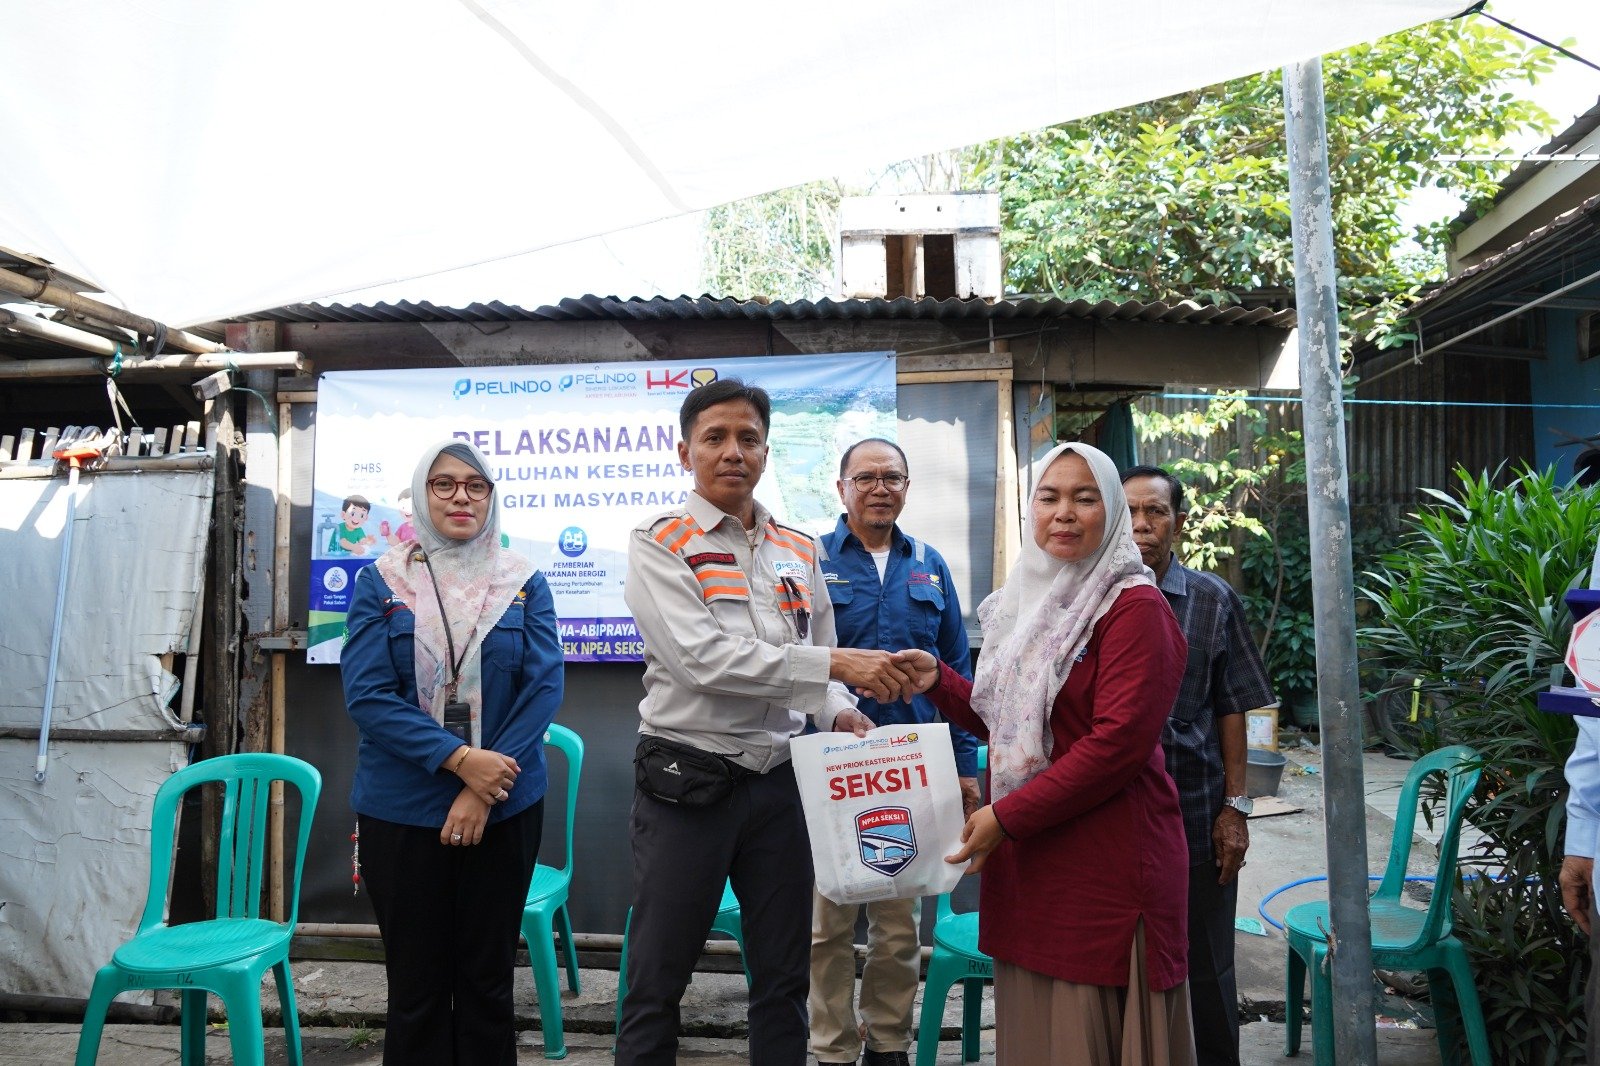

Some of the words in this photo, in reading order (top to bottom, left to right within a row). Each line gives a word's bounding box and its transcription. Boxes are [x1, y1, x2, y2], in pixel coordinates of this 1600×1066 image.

[575, 373, 636, 385] PELINDO
[475, 381, 552, 395] PELINDO
[353, 462, 382, 473] PHBS
[587, 463, 694, 479] KESEHAT
[503, 493, 546, 508] GIZI
[581, 642, 611, 655] NPEA
[830, 744, 859, 752] PELINDO
[826, 764, 842, 772] NEW
[843, 761, 864, 770] PRIOK
[865, 757, 896, 766] EASTERN
[897, 752, 923, 762] ACCESS
[829, 767, 911, 800] SEKSI
[915, 764, 928, 787] 1
[861, 816, 880, 826] NPEA
[968, 959, 988, 974] RW
[128, 974, 144, 987] RW
